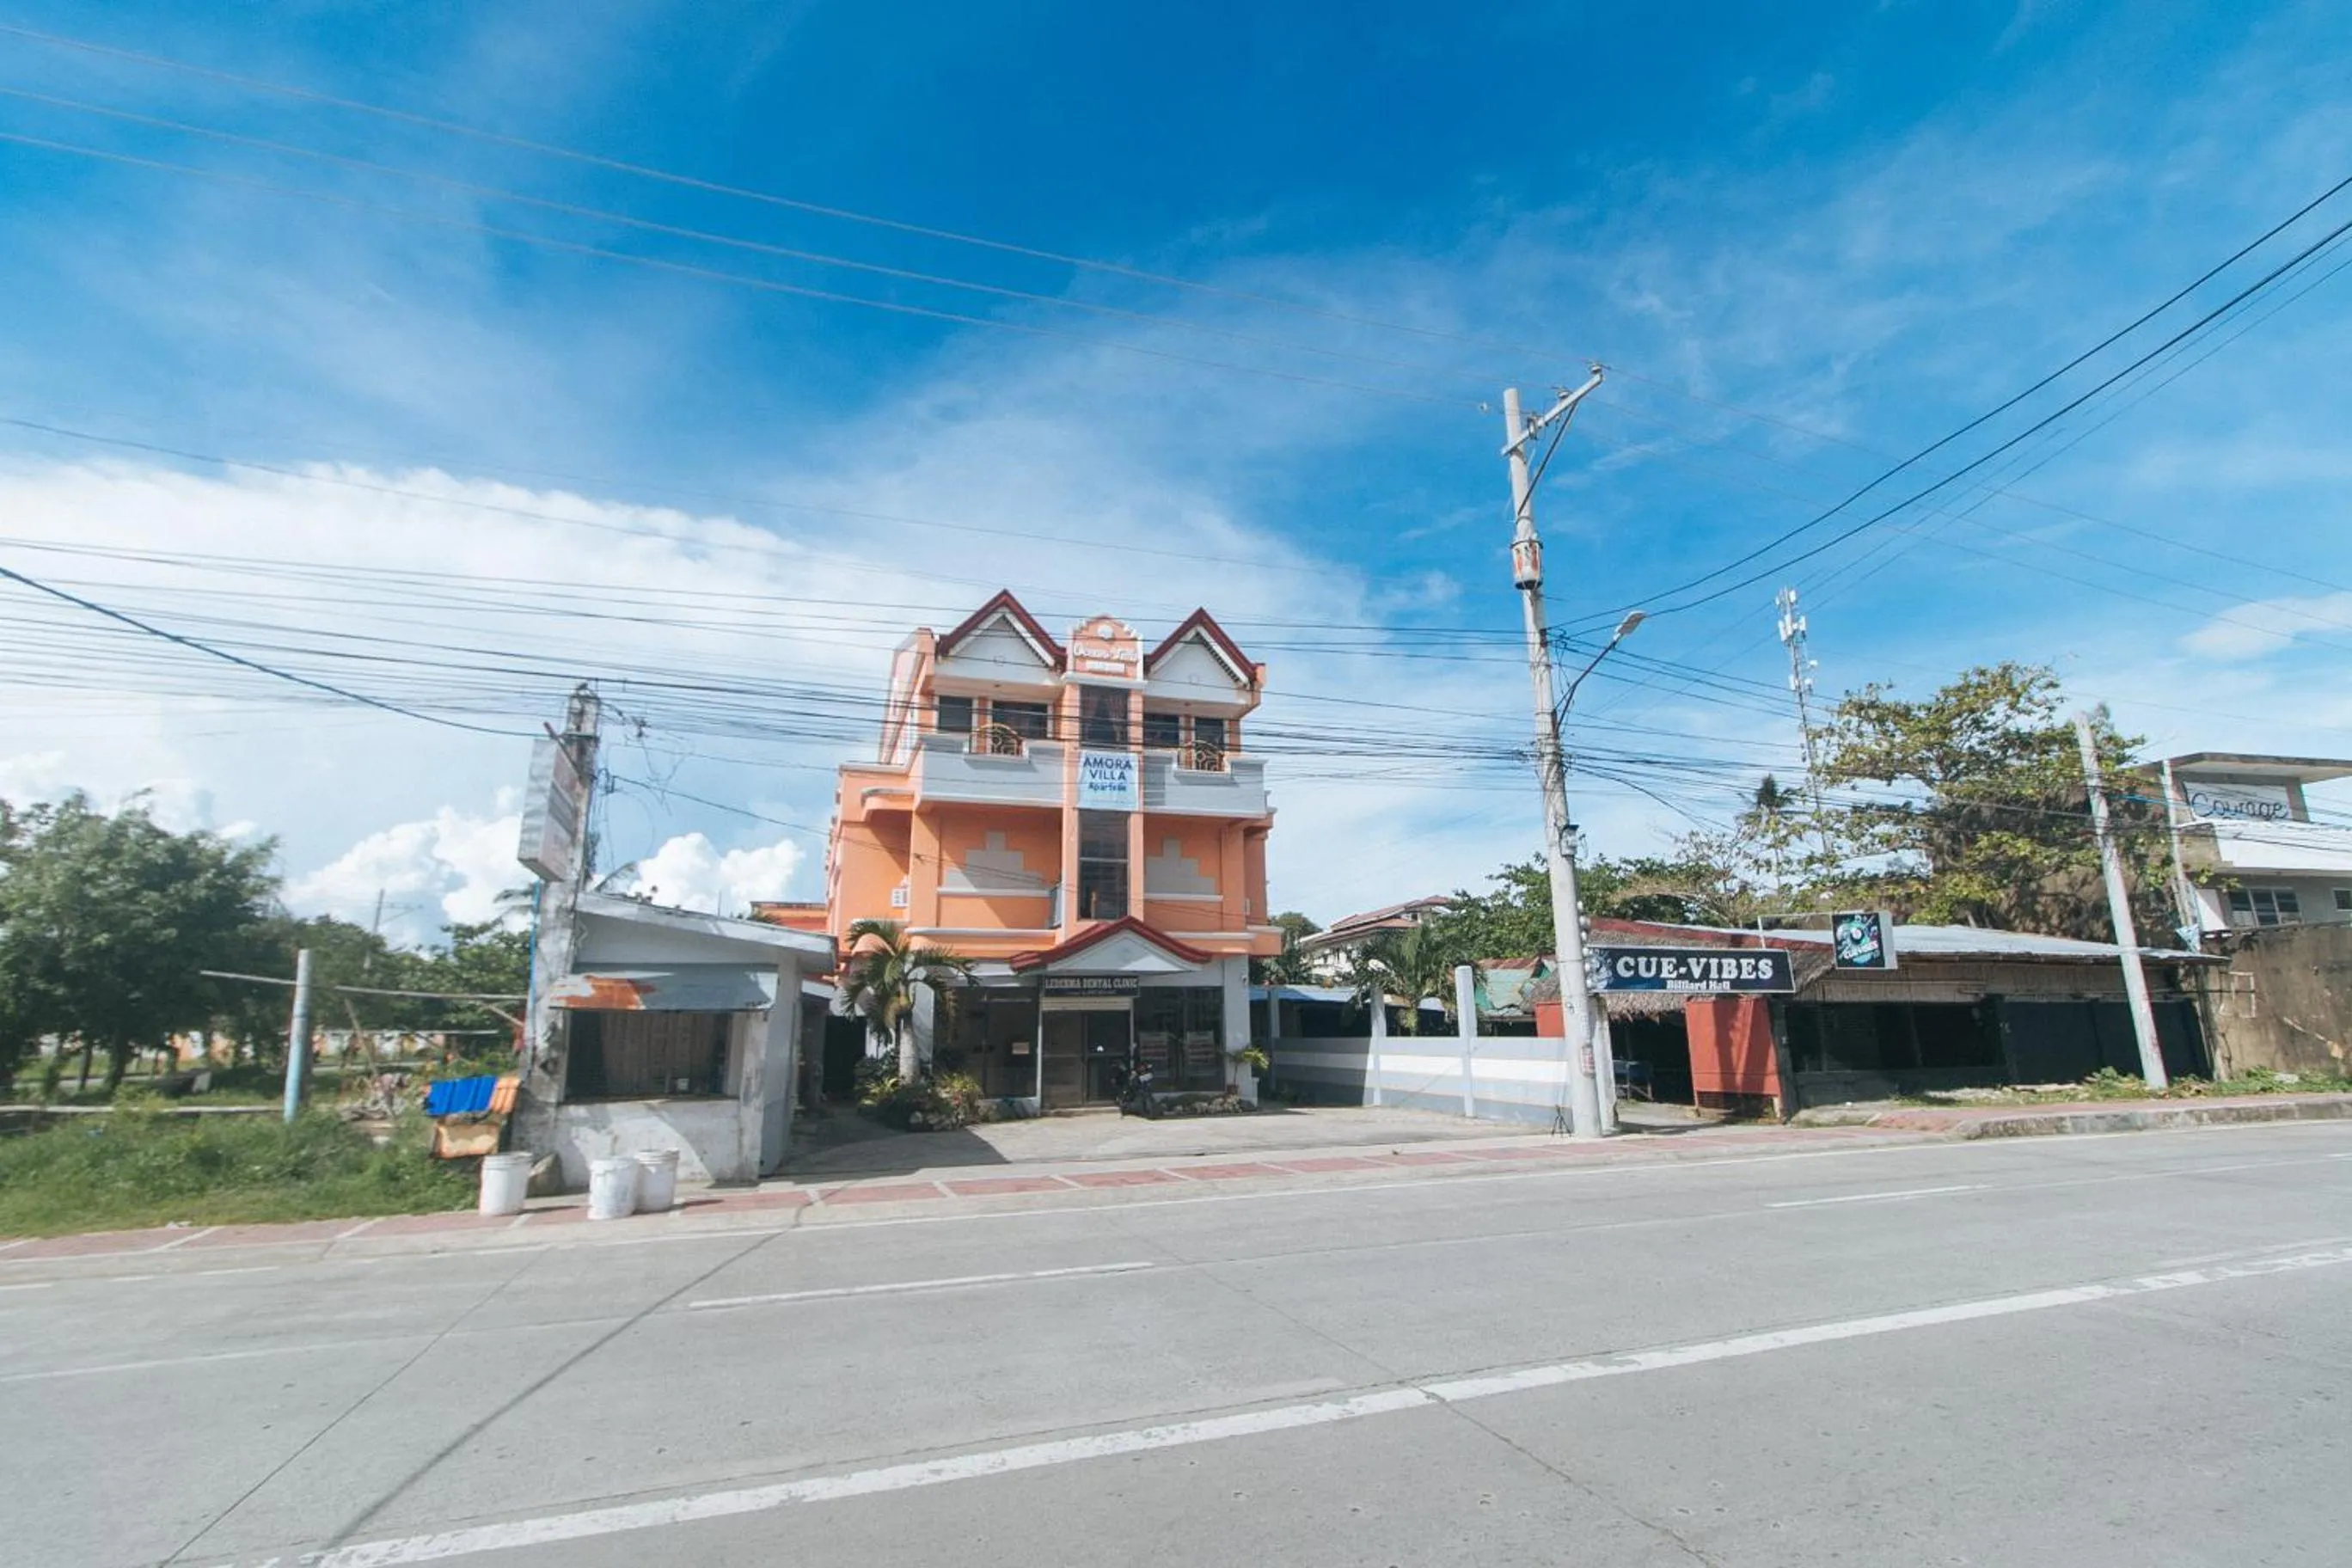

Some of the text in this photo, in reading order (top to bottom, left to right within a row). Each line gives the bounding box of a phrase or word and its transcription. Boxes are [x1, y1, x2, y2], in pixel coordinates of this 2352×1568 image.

[1083, 756, 1132, 770] AMORA
[1089, 769, 1126, 781] VILLA
[1615, 956, 1773, 980] CUE-VIBES
[1666, 980, 1706, 990] Billiard
